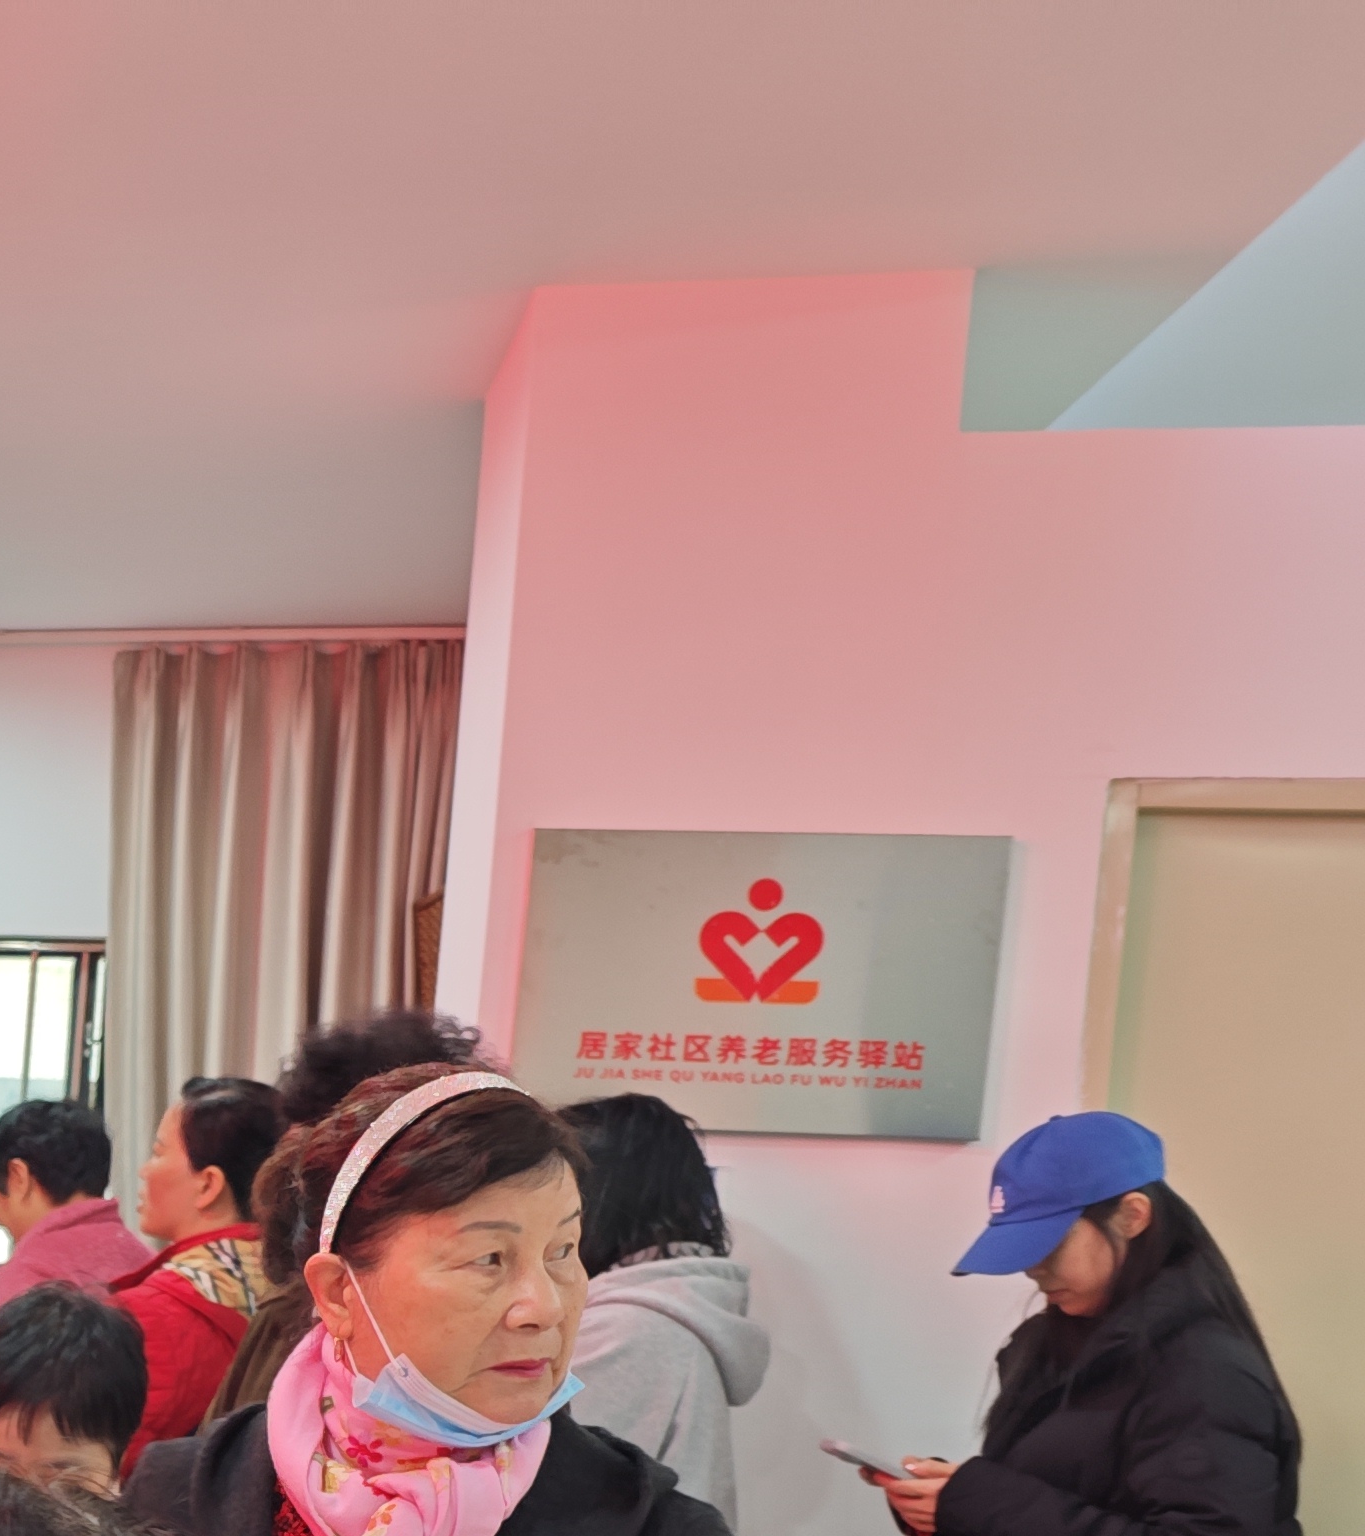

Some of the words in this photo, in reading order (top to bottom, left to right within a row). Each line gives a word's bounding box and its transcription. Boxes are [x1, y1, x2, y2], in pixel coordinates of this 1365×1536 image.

[575, 1029, 925, 1071] 居家社区养老服务驿站
[573, 1066, 595, 1079] JU
[600, 1067, 626, 1080] JIA
[630, 1067, 663, 1081] SHE
[668, 1068, 695, 1083] QU
[700, 1070, 745, 1084] YANG
[750, 1072, 785, 1085] LAO
[790, 1074, 812, 1086] FU
[818, 1075, 846, 1087] WU
[853, 1076, 869, 1087] YI
[873, 1077, 922, 1090] ZHAN
